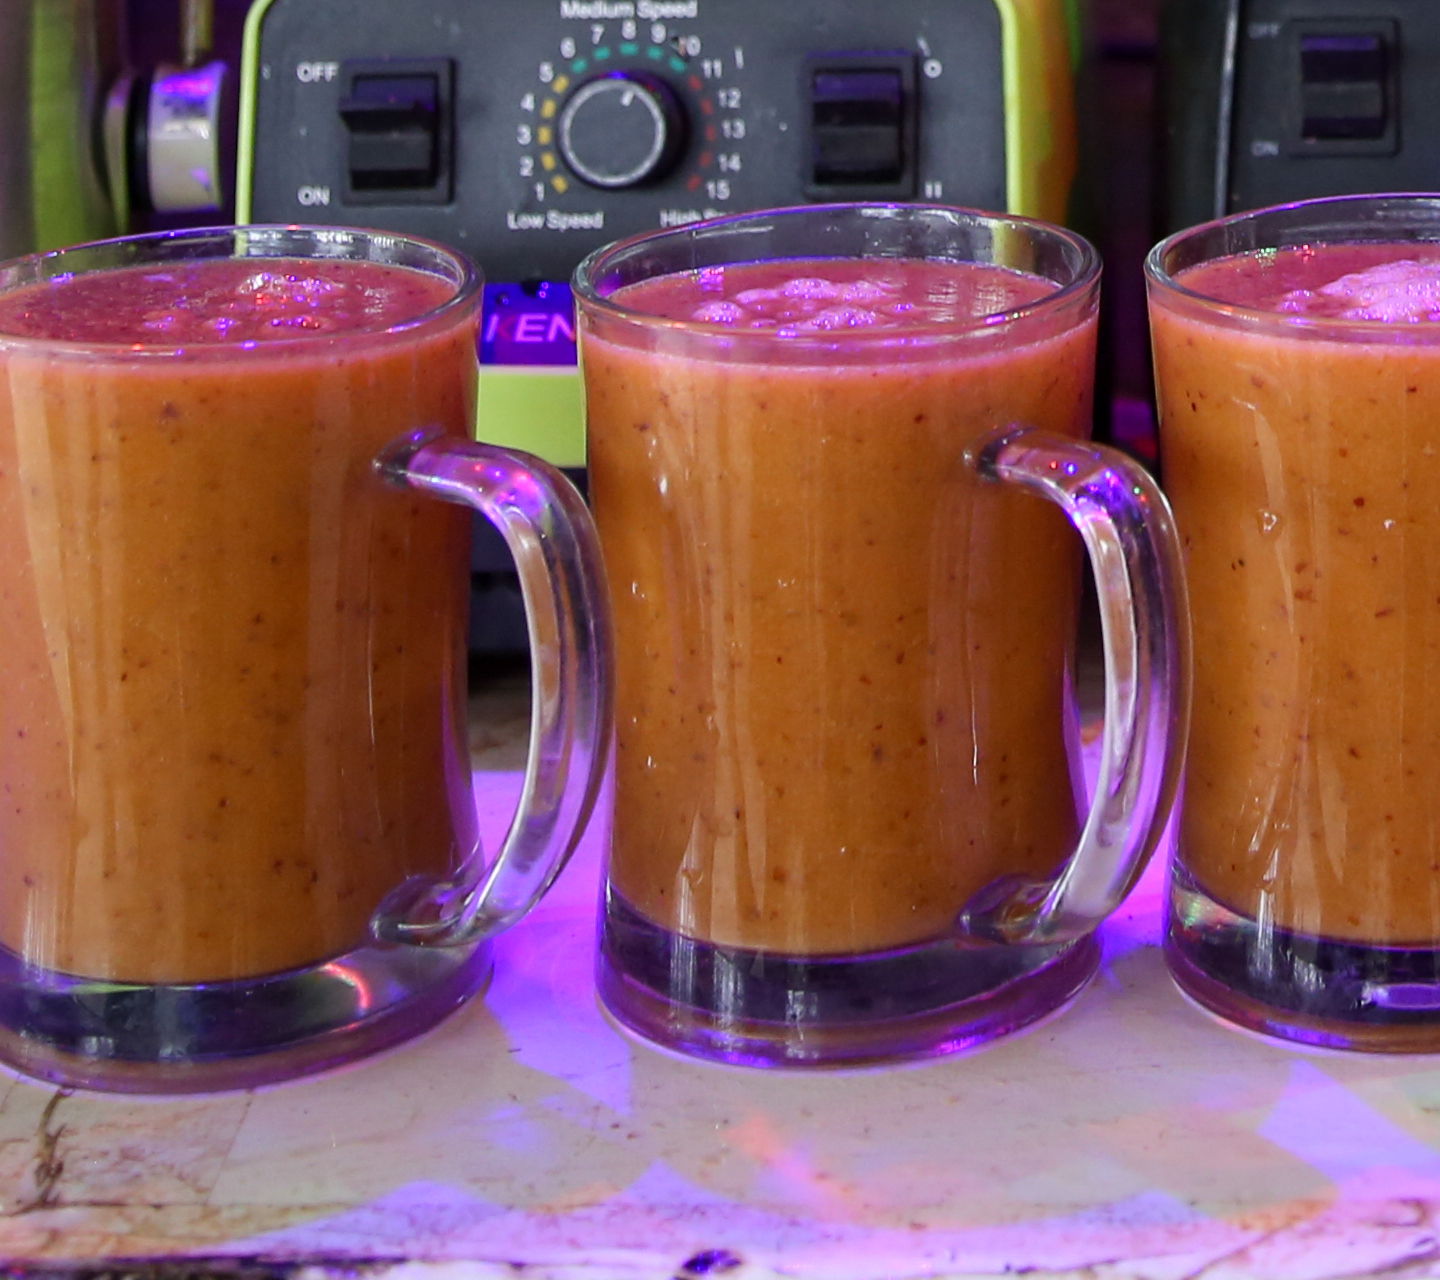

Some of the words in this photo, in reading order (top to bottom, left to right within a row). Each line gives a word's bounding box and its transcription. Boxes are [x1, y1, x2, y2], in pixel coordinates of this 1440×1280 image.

[560, 0, 635, 19] Medium
[591, 24, 604, 44] 7
[622, 19, 636, 40] 8
[651, 22, 666, 43] 9
[560, 37, 575, 58] 6
[296, 61, 339, 83] OFF
[539, 61, 554, 83] 5
[702, 59, 722, 79] 11
[520, 92, 535, 112] 4
[718, 88, 741, 108] 12
[517, 124, 532, 145] 3
[722, 119, 746, 139] 13
[519, 155, 534, 177] 2
[718, 152, 741, 172] 14
[298, 185, 330, 205] ON
[535, 182, 545, 202] 1
[707, 179, 730, 200] 15
[507, 211, 544, 230] Low
[546, 210, 604, 232] Speed
